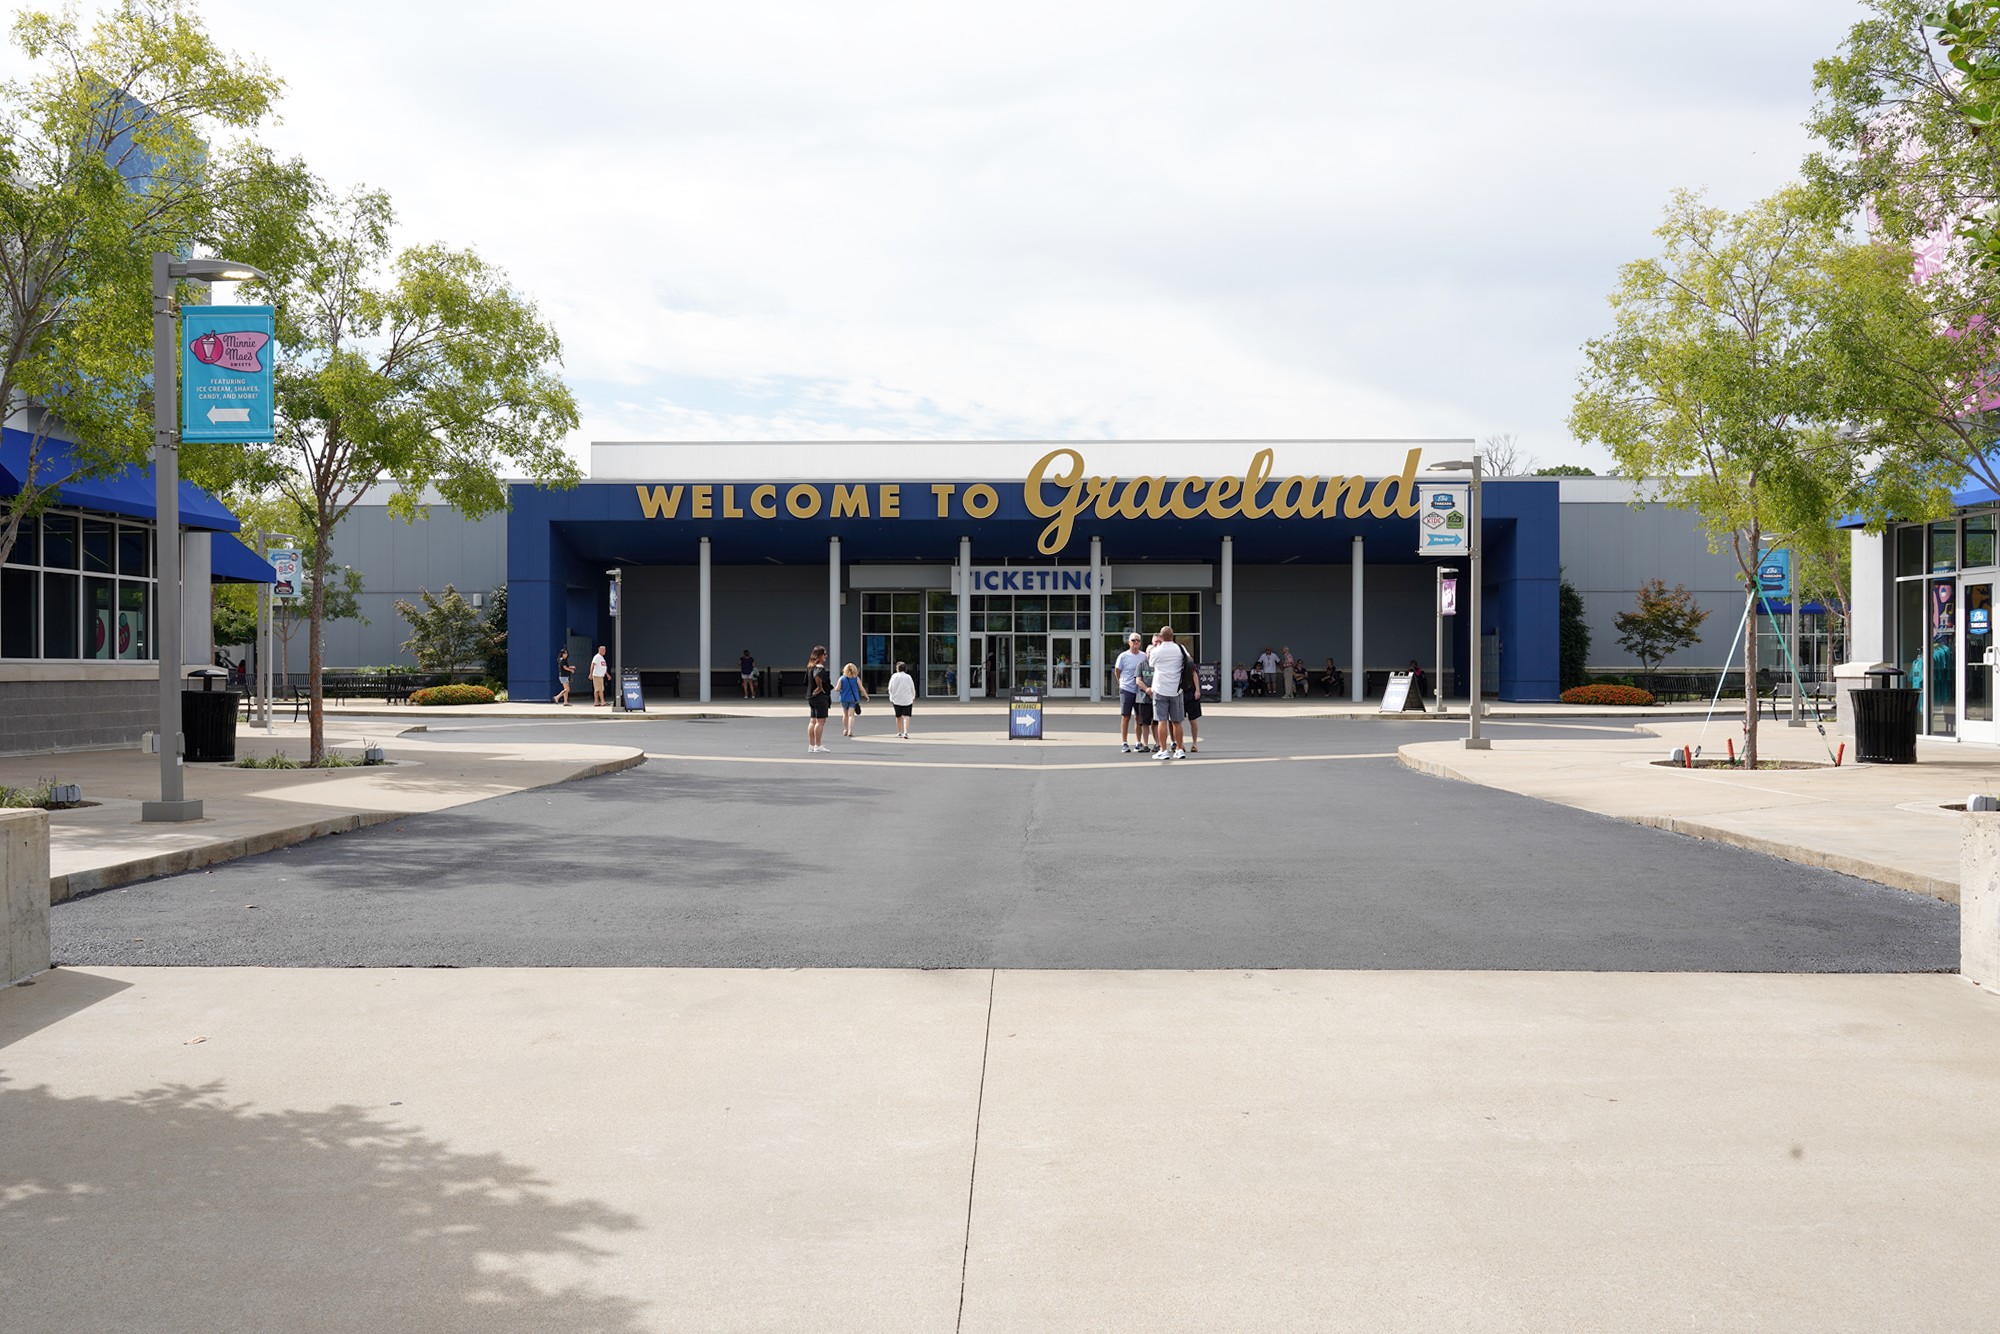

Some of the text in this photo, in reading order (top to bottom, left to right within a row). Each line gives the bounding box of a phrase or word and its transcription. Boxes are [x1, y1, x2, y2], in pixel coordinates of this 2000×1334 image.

[223, 335, 256, 348] Minnie
[225, 348, 253, 361] Mae's
[234, 385, 261, 393] SHAKES,
[636, 447, 1423, 556] WELCOME TO Graceland
[279, 564, 295, 572] BBQ
[959, 571, 1104, 590] ICKETIN
